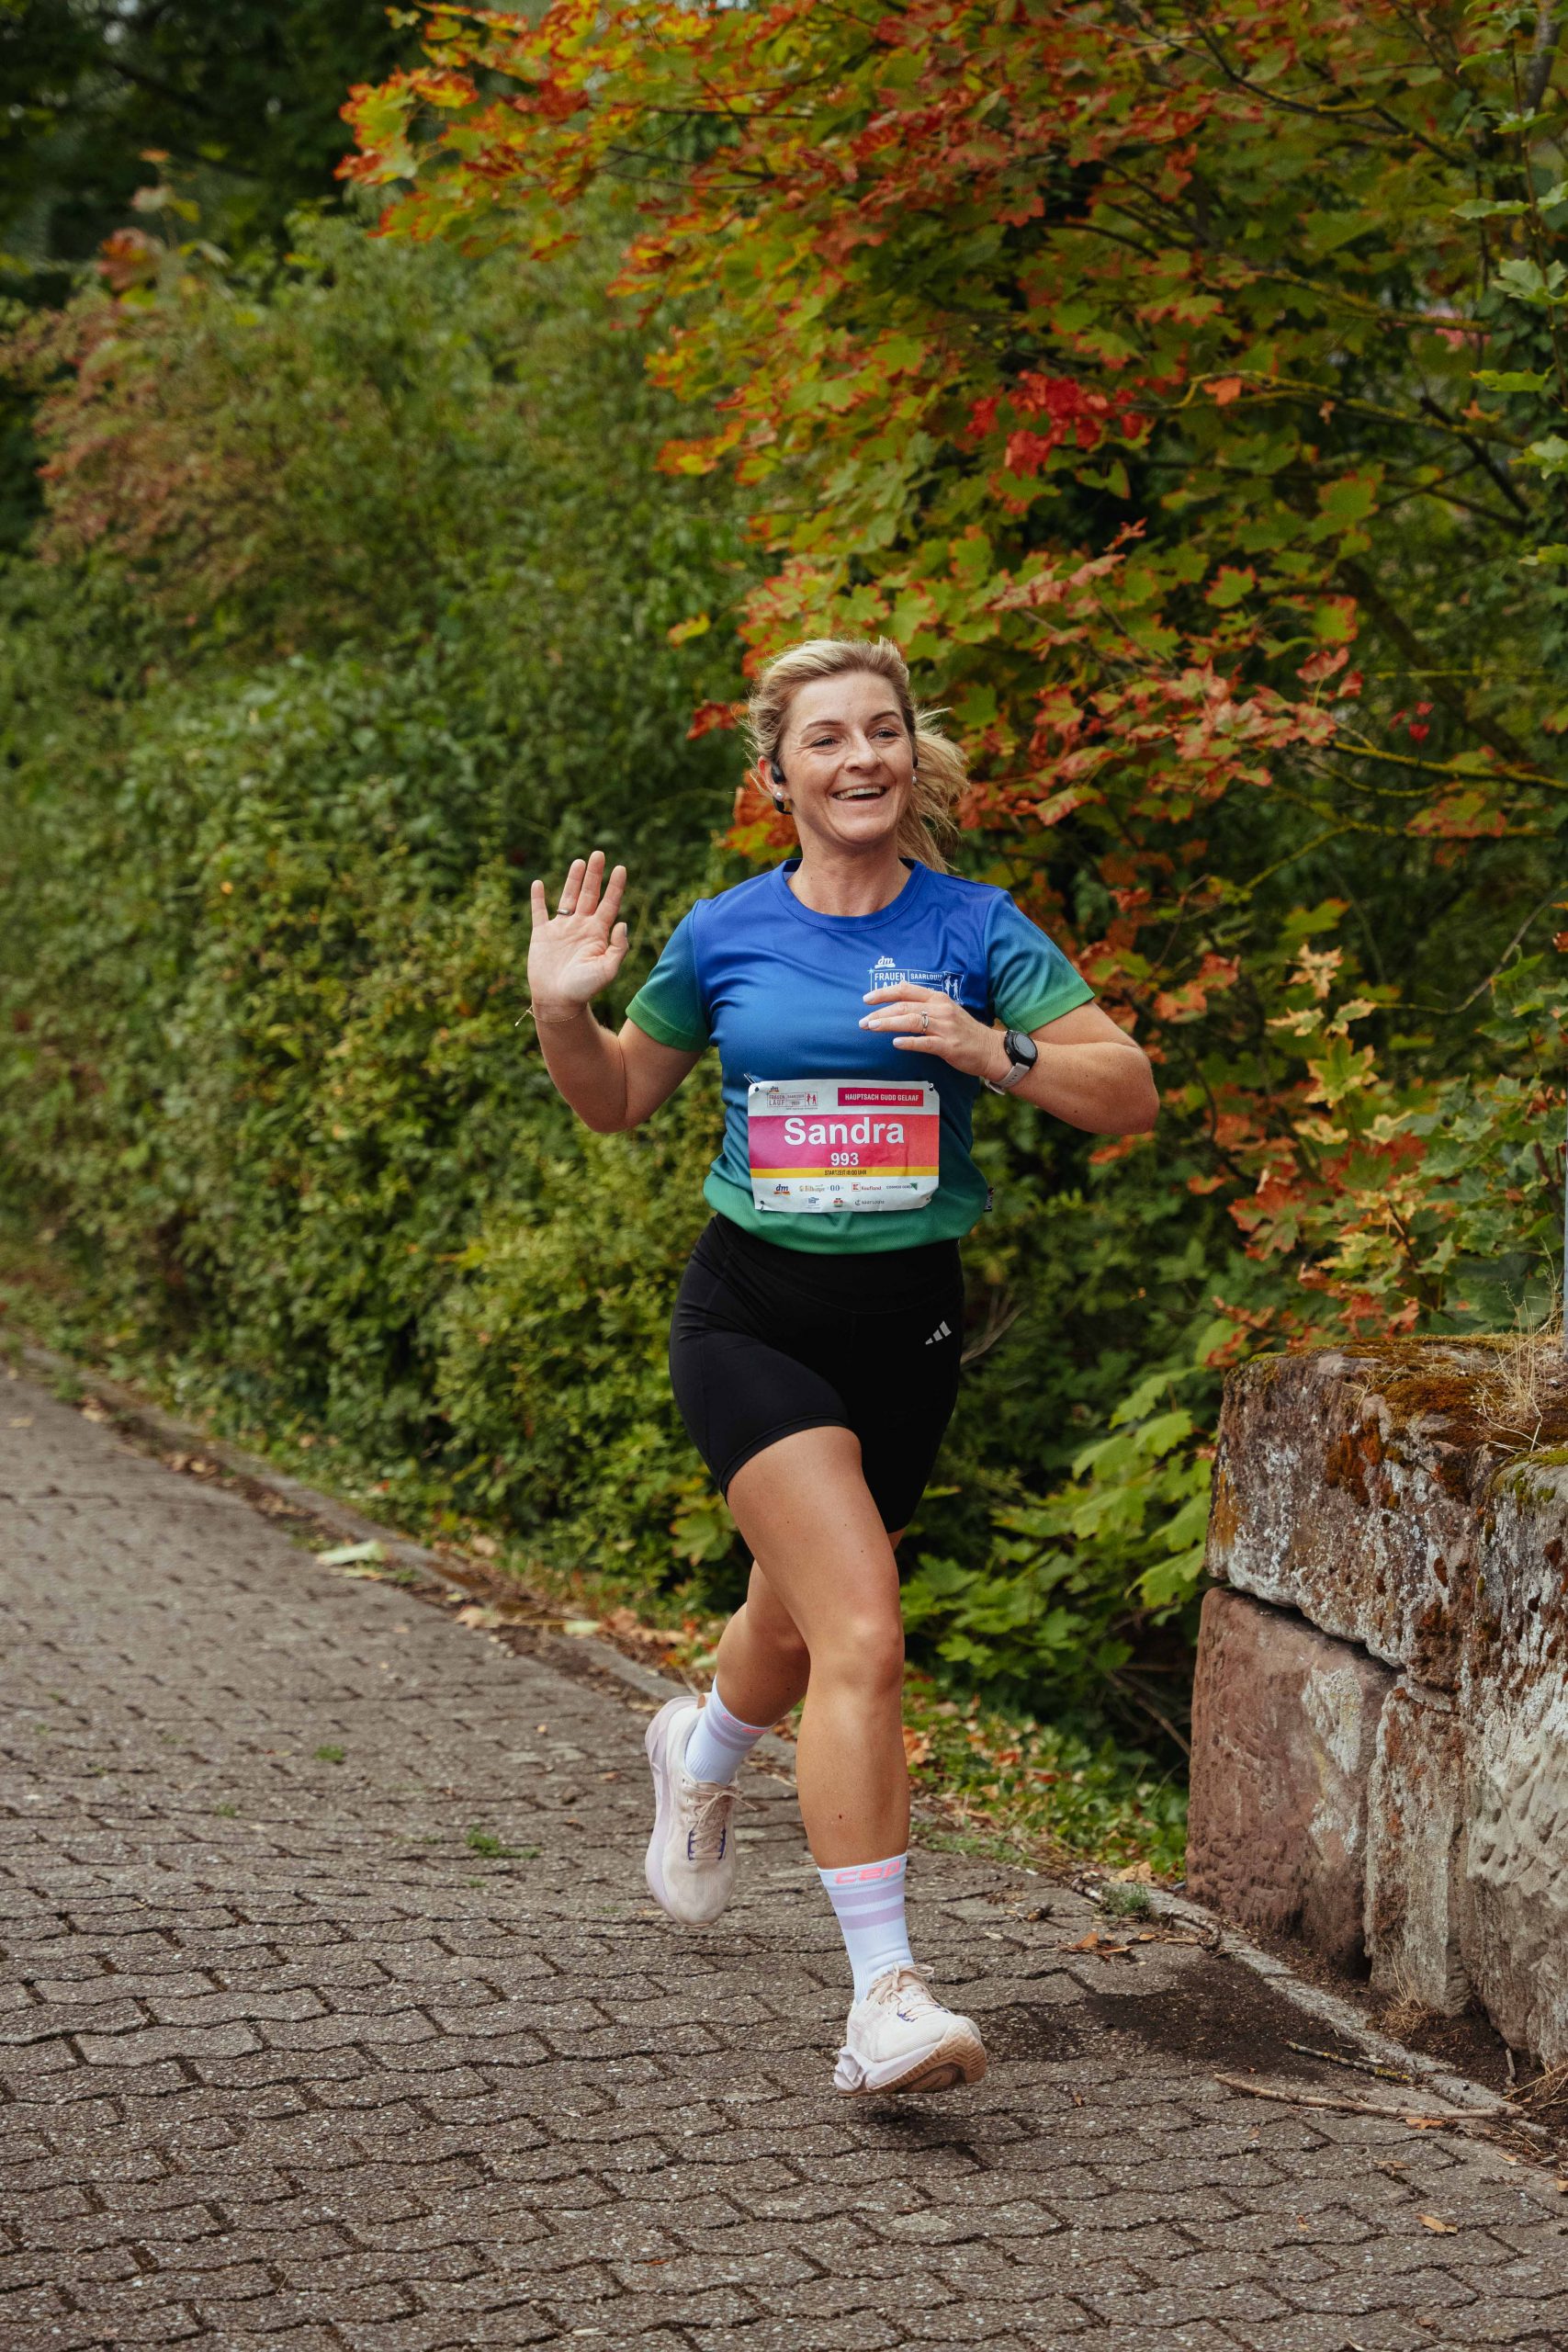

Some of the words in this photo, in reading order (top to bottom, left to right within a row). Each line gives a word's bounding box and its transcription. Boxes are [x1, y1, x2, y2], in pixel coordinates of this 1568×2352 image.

[877, 956, 893, 965] dm
[874, 972, 906, 981] FRAUEN
[910, 973, 943, 982] SAARLOUIS
[784, 1116, 906, 1146] Sandra
[830, 1152, 860, 1167] 993
[775, 1183, 789, 1192] dm
[835, 1860, 901, 1884] cep
